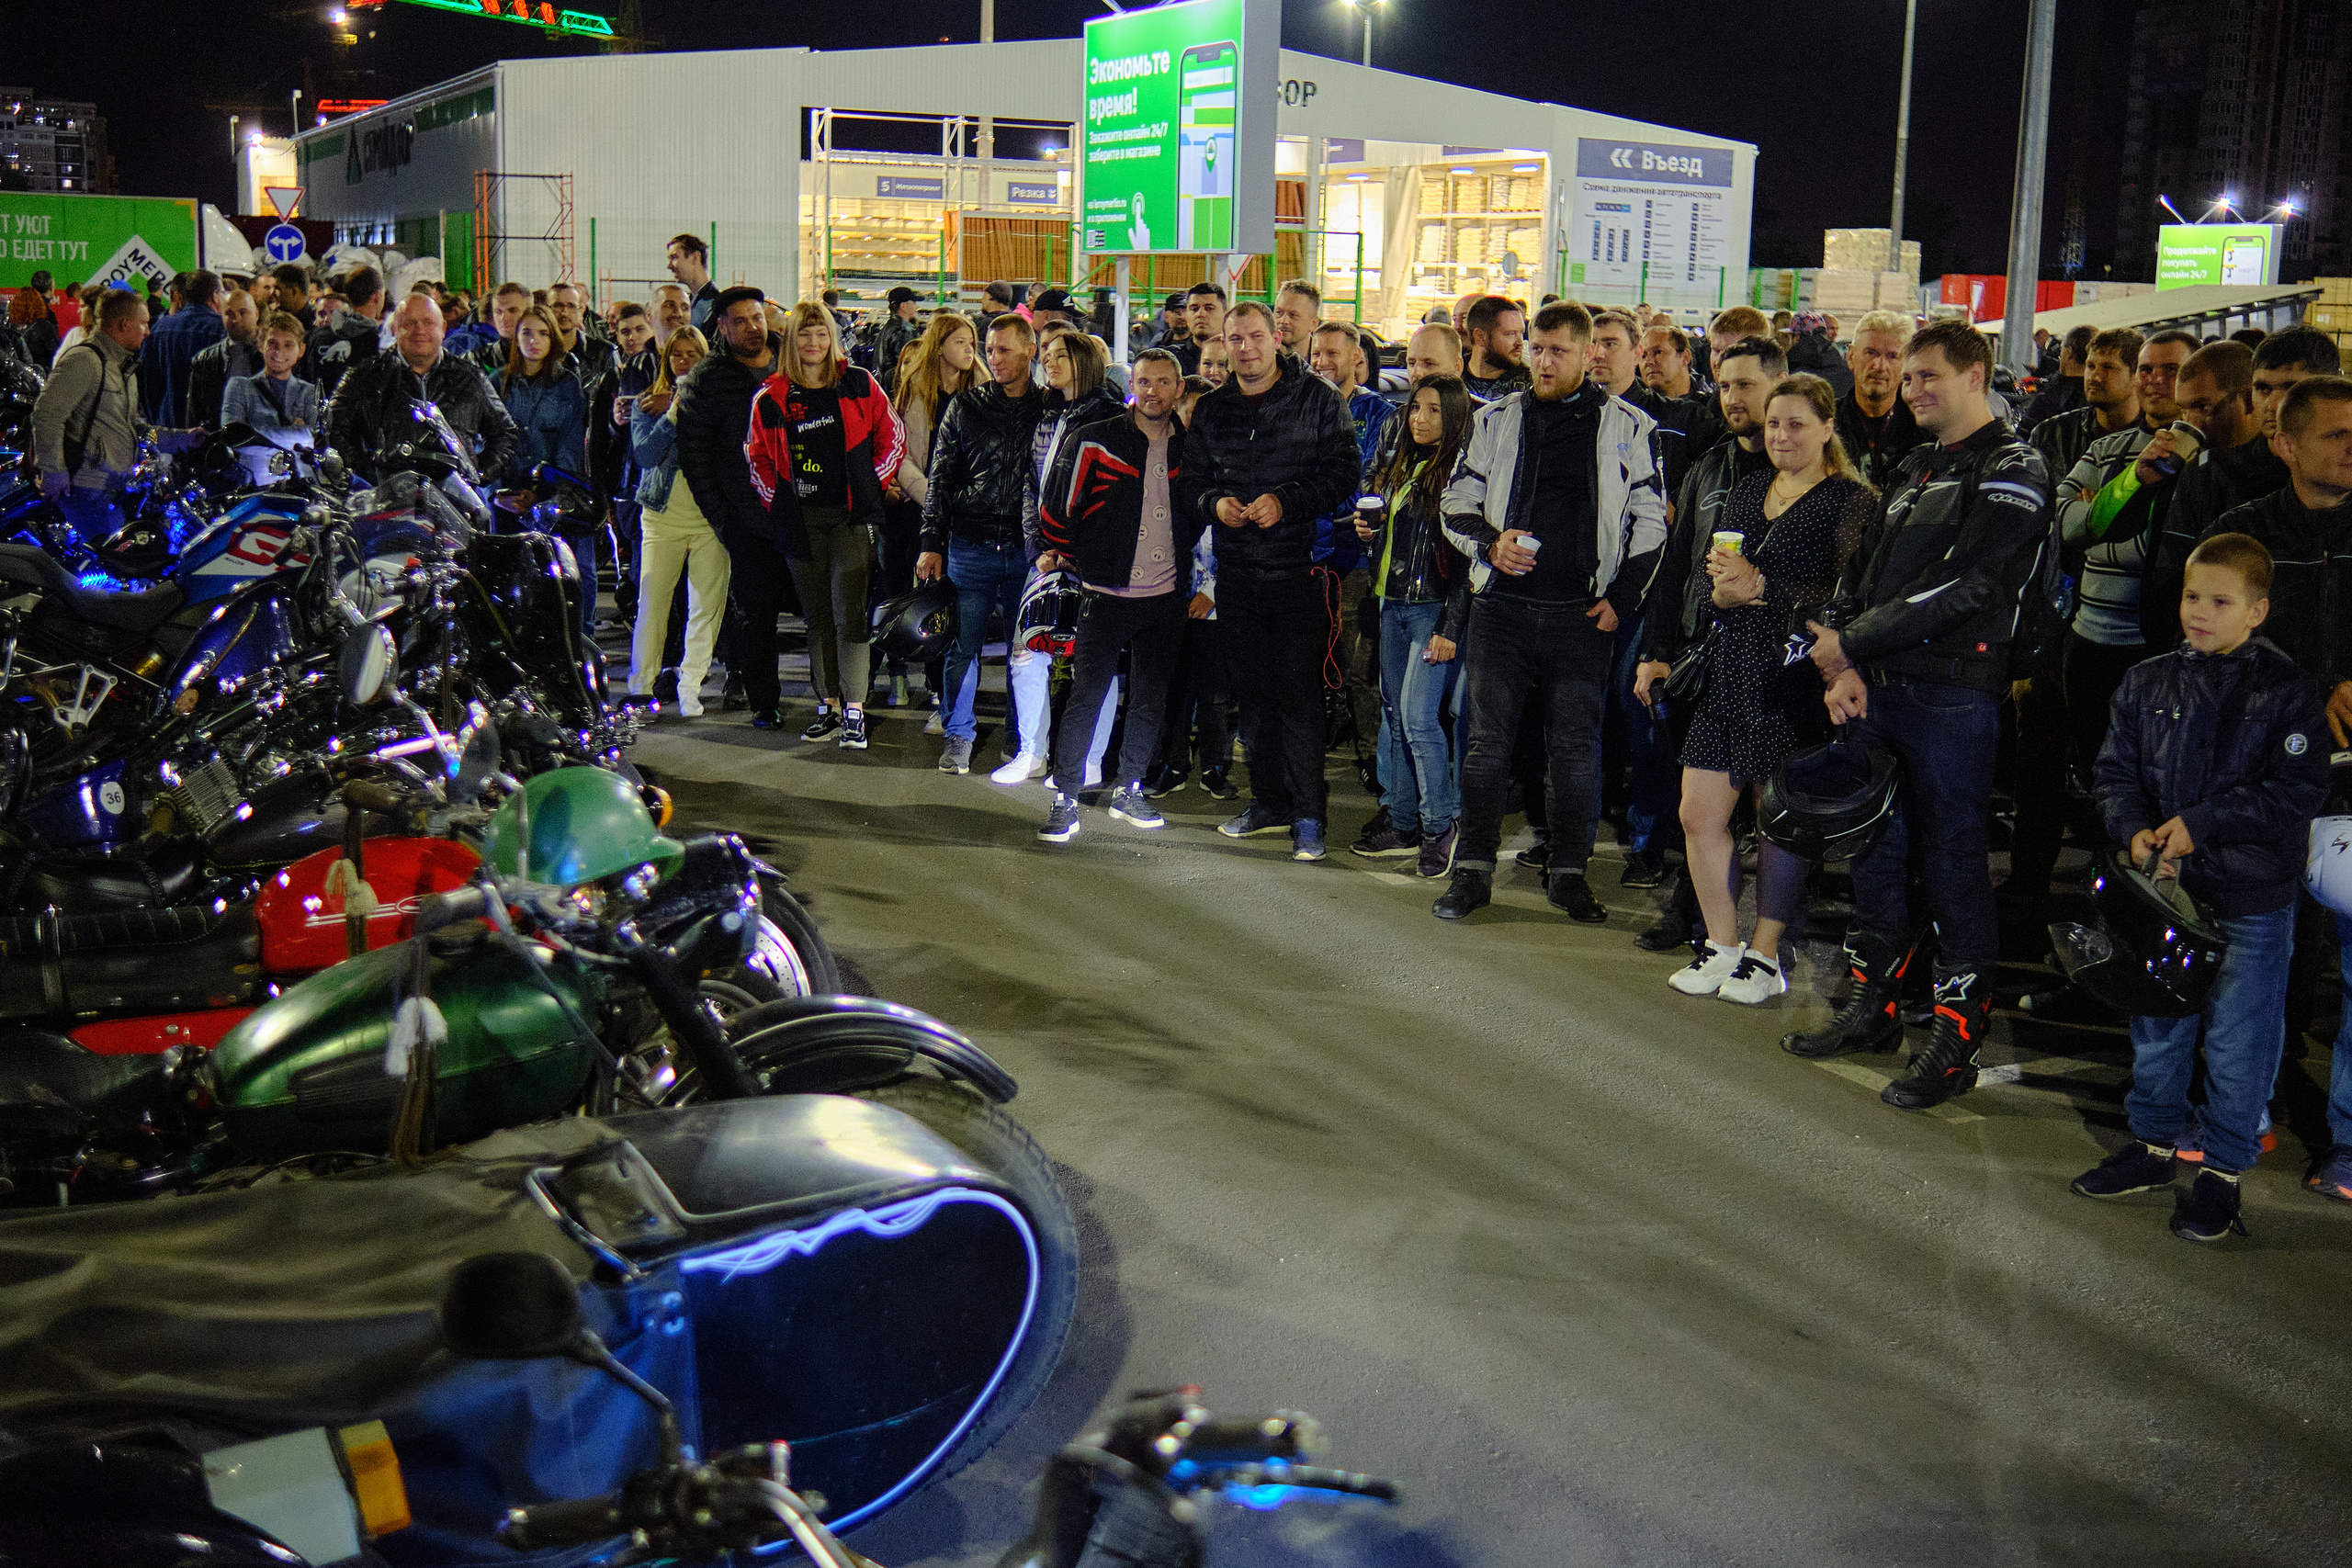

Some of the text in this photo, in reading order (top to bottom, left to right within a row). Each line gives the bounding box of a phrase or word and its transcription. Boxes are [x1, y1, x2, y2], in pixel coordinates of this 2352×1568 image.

[1089, 51, 1170, 85] Экономьте
[1089, 86, 1137, 126] время!
[1088, 121, 1169, 144] Закажите онлайн 24/7
[1642, 150, 1703, 178] Въезд
[880, 181, 890, 192] 5
[1012, 186, 1046, 198] Резка
[15, 215, 51, 236] УЮТ
[13, 239, 54, 262] ЕДЕТ
[58, 241, 89, 261] ТУТ
[2163, 246, 2217, 256] Продолжайте
[2162, 259, 2198, 268] покупать
[2161, 270, 2208, 279] онлайн 24/7
[802, 459, 823, 473] do.
[106, 791, 121, 805] 36
